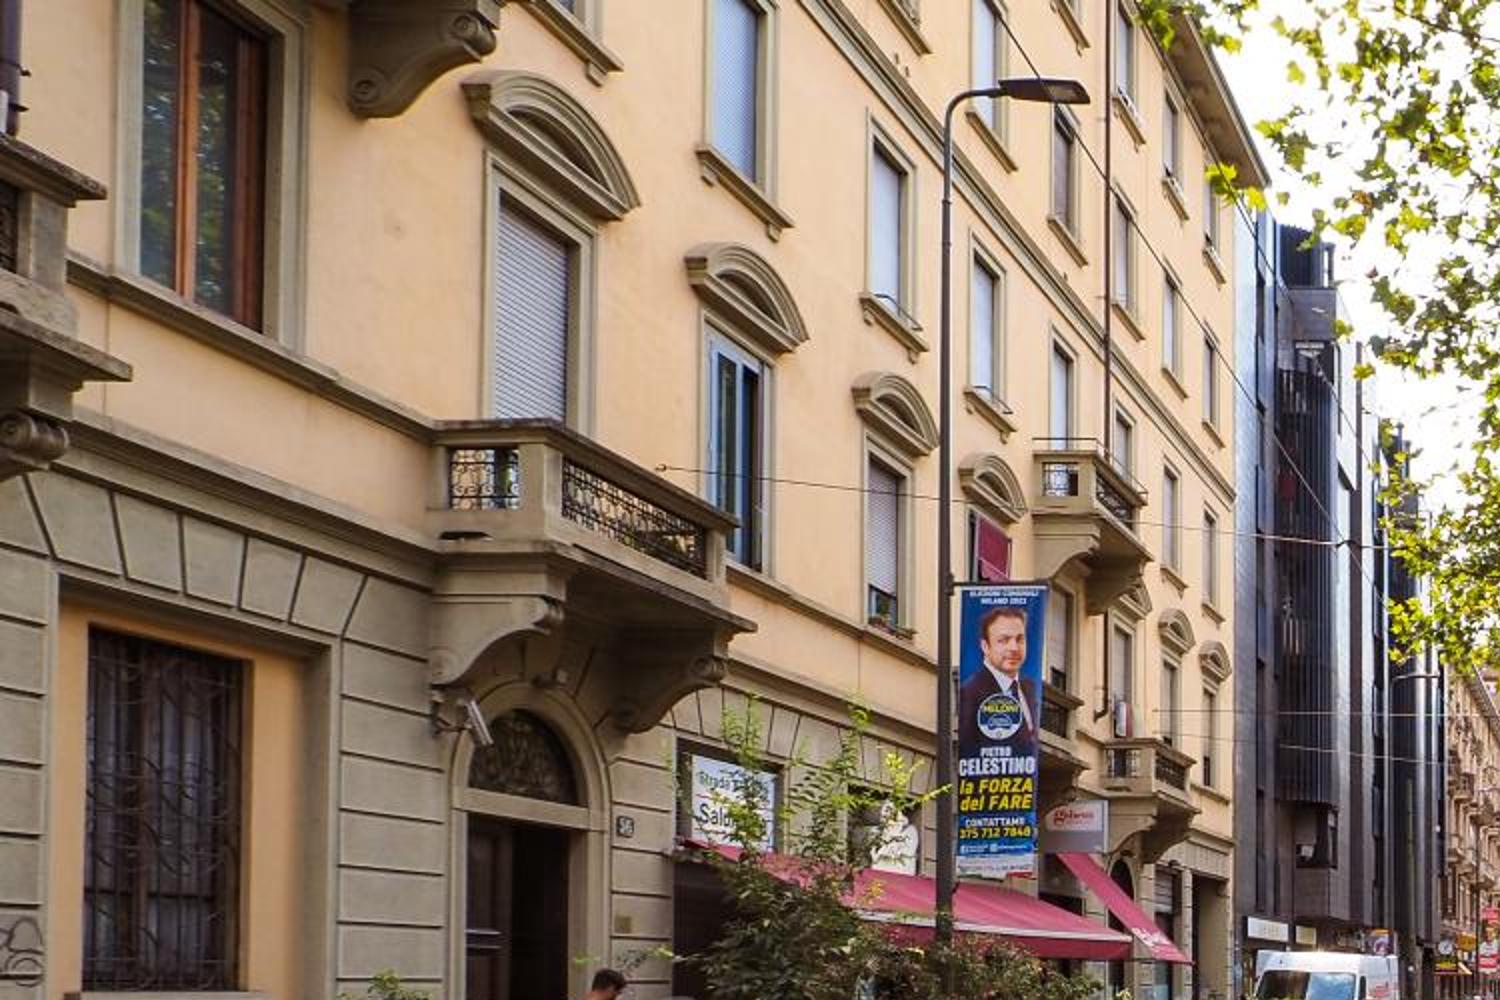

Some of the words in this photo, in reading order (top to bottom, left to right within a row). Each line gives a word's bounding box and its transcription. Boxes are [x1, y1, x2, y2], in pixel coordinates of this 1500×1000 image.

[980, 746, 1012, 757] PIETRO
[959, 756, 1036, 777] CELESTINO
[960, 779, 974, 795] la
[979, 777, 1034, 794] FORZA
[960, 794, 985, 812] del
[989, 793, 1033, 811] FARE
